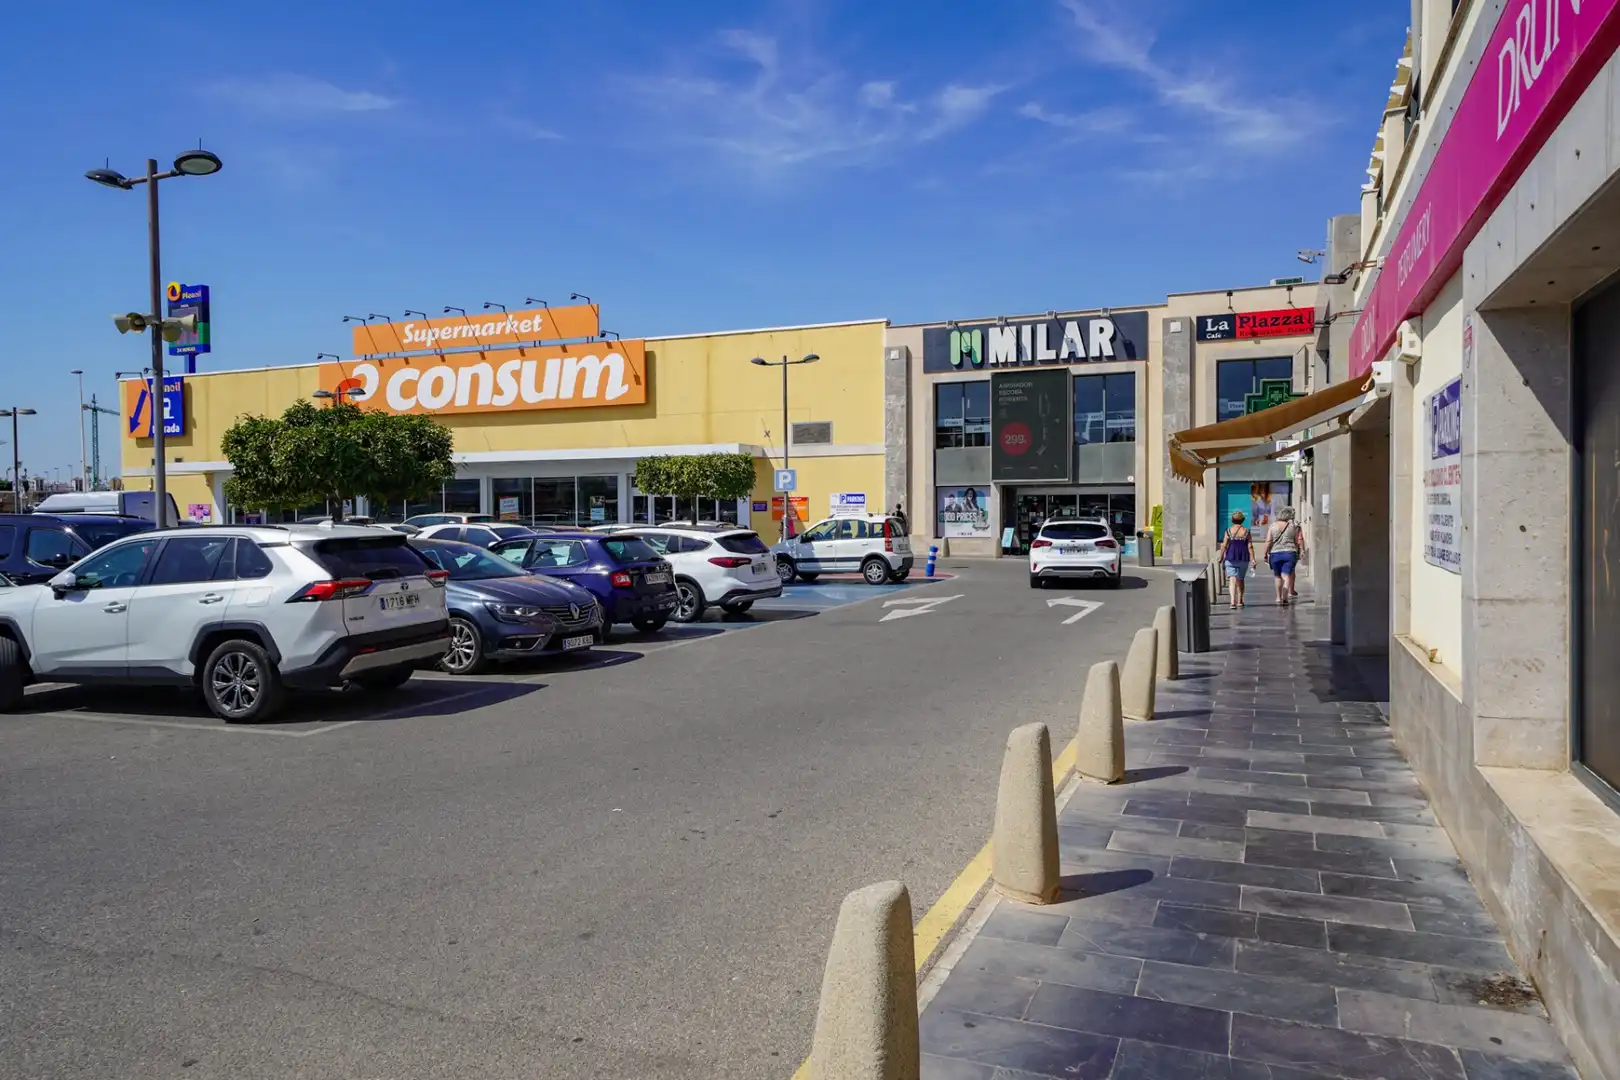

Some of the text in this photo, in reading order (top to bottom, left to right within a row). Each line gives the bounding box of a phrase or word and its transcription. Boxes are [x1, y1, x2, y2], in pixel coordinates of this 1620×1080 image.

[403, 313, 543, 347] Supermarket
[1206, 313, 1304, 332] La Plazza
[988, 318, 1115, 364] MILAR
[386, 352, 629, 412] consum
[778, 471, 792, 489] P
